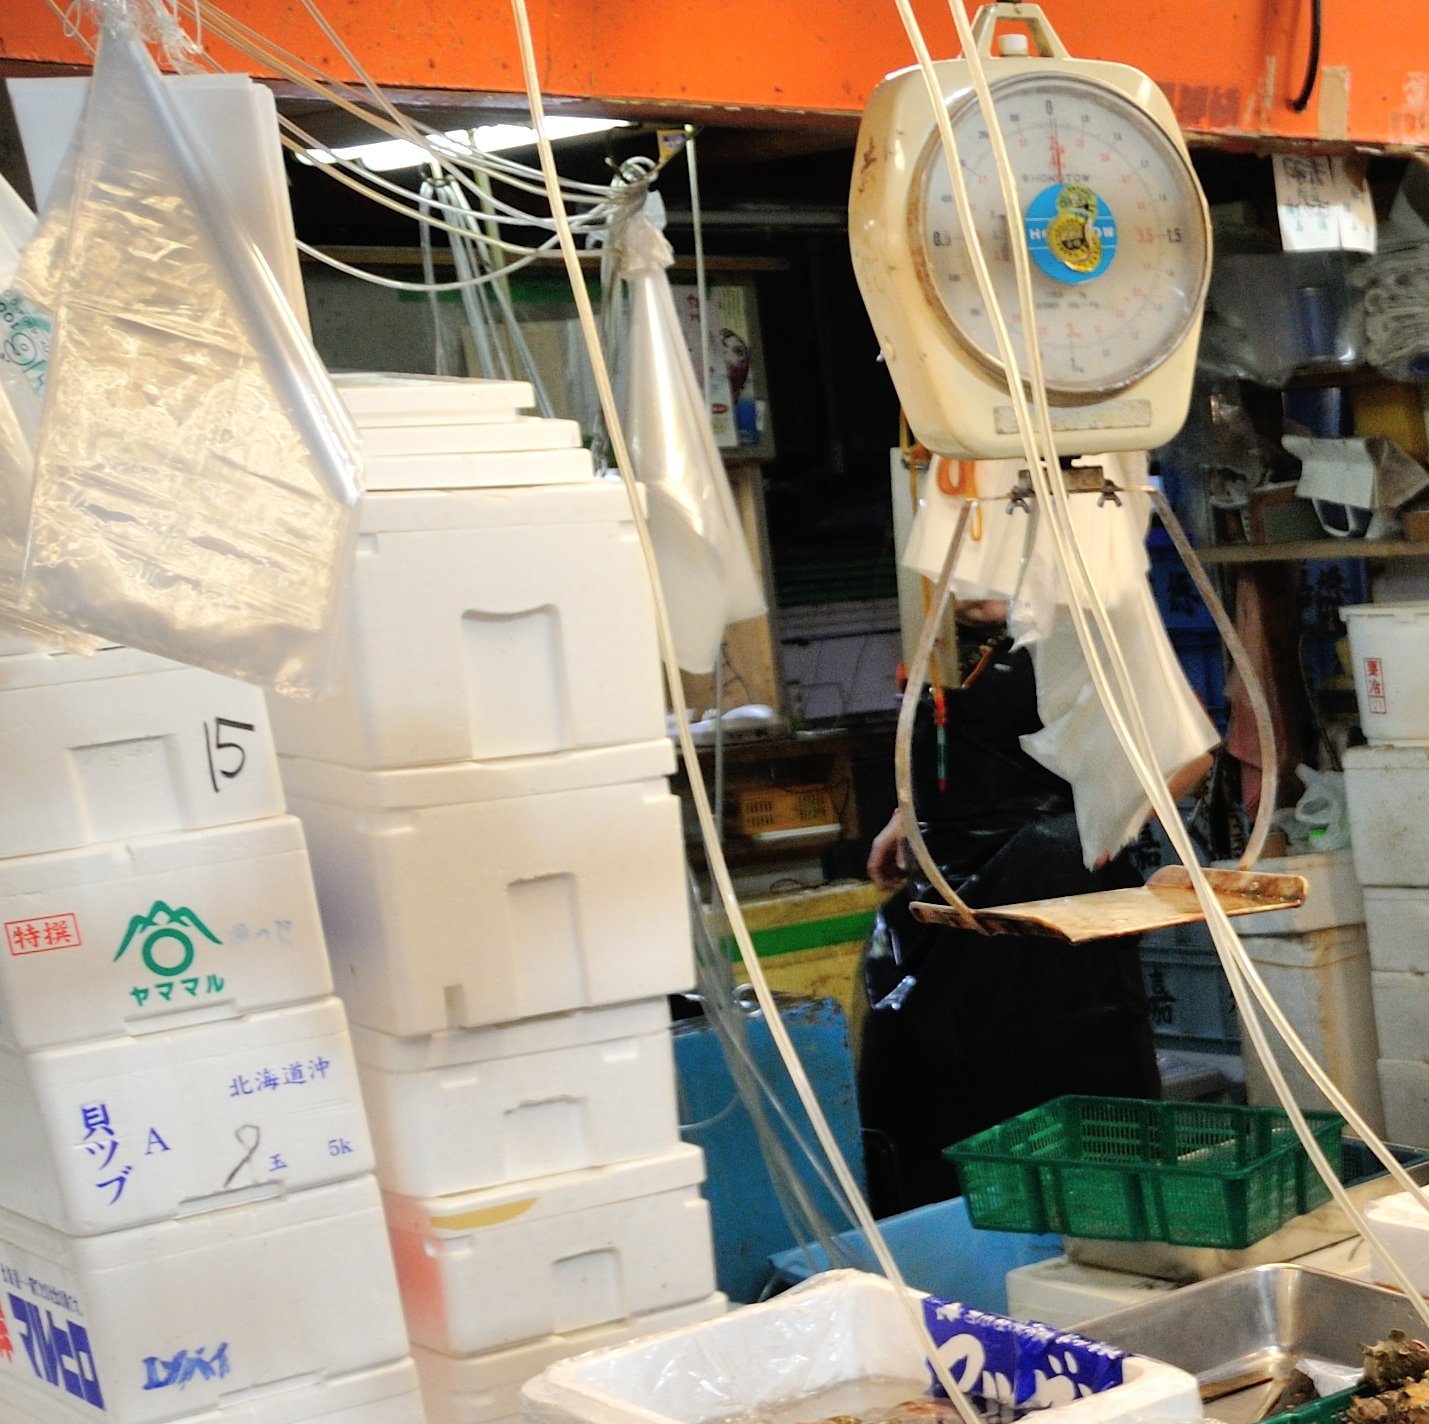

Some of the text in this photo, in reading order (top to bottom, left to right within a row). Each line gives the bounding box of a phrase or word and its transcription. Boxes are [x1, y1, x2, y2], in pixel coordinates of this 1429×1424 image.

[203, 716, 255, 793] 15
[129, 973, 226, 1007] ヤママル
[229, 1055, 331, 1098] 北海道沖
[80, 1103, 133, 1206] 貝ツブ
[143, 1127, 172, 1156] A
